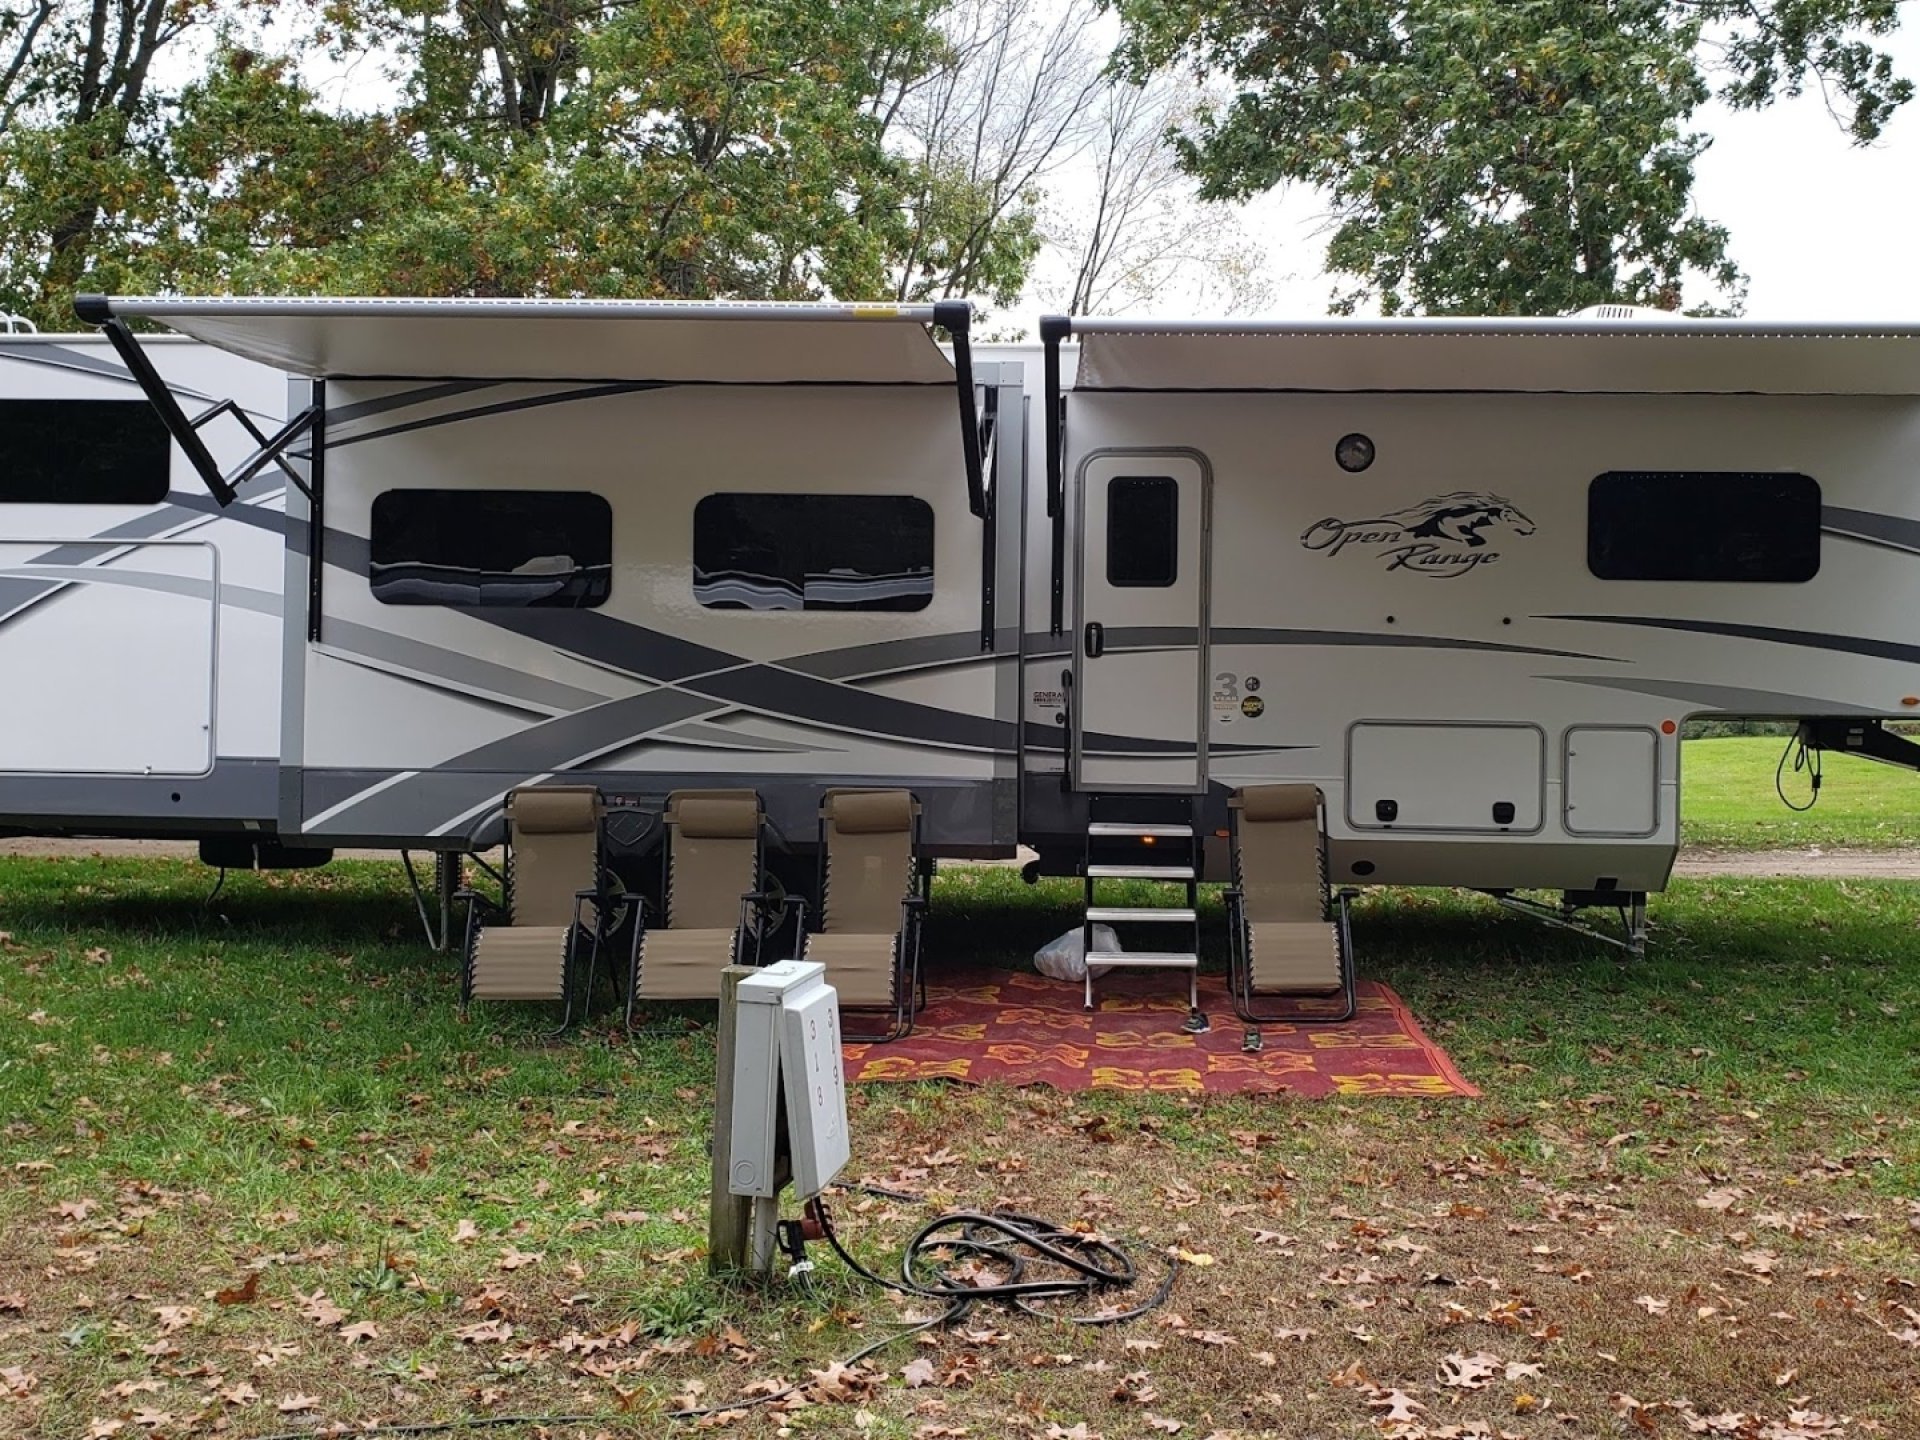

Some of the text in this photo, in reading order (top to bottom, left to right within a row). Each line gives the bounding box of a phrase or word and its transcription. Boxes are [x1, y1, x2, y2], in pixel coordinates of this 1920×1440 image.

[1300, 517, 1404, 557] Open
[1376, 543, 1500, 578] Range
[1214, 672, 1238, 697] 3
